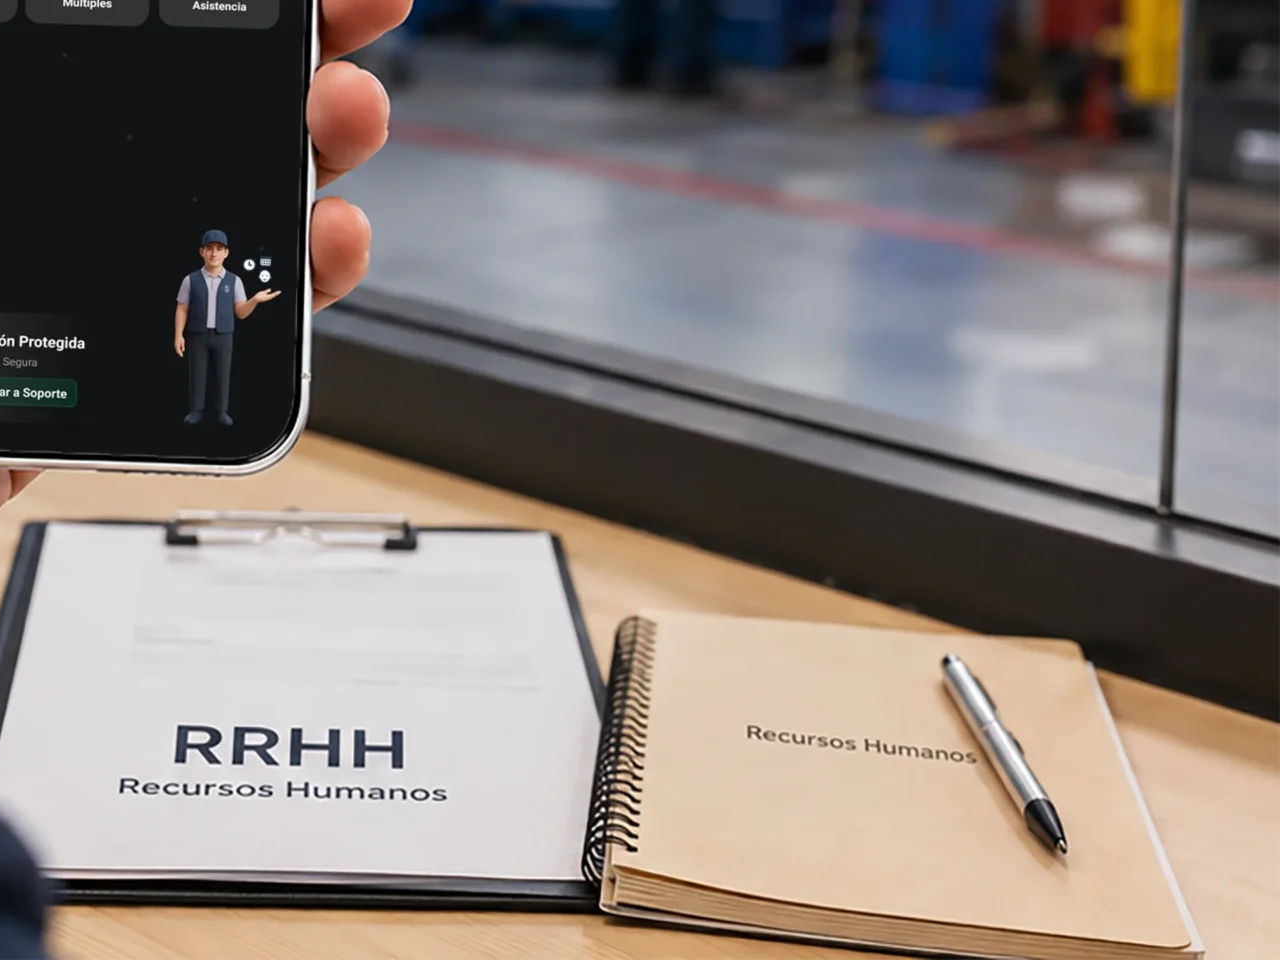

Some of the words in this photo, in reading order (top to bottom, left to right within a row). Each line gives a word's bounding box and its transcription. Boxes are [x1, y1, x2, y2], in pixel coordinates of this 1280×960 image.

[192, 1, 246, 11] Asistencia
[19, 336, 85, 351] Protegida
[3, 357, 37, 368] Segura
[23, 388, 67, 400] Soporte
[174, 725, 403, 769] RRHH
[747, 725, 856, 750] Recursos
[864, 738, 977, 764] Humanos
[119, 778, 273, 797] Recursos
[287, 781, 447, 801] Humanos
